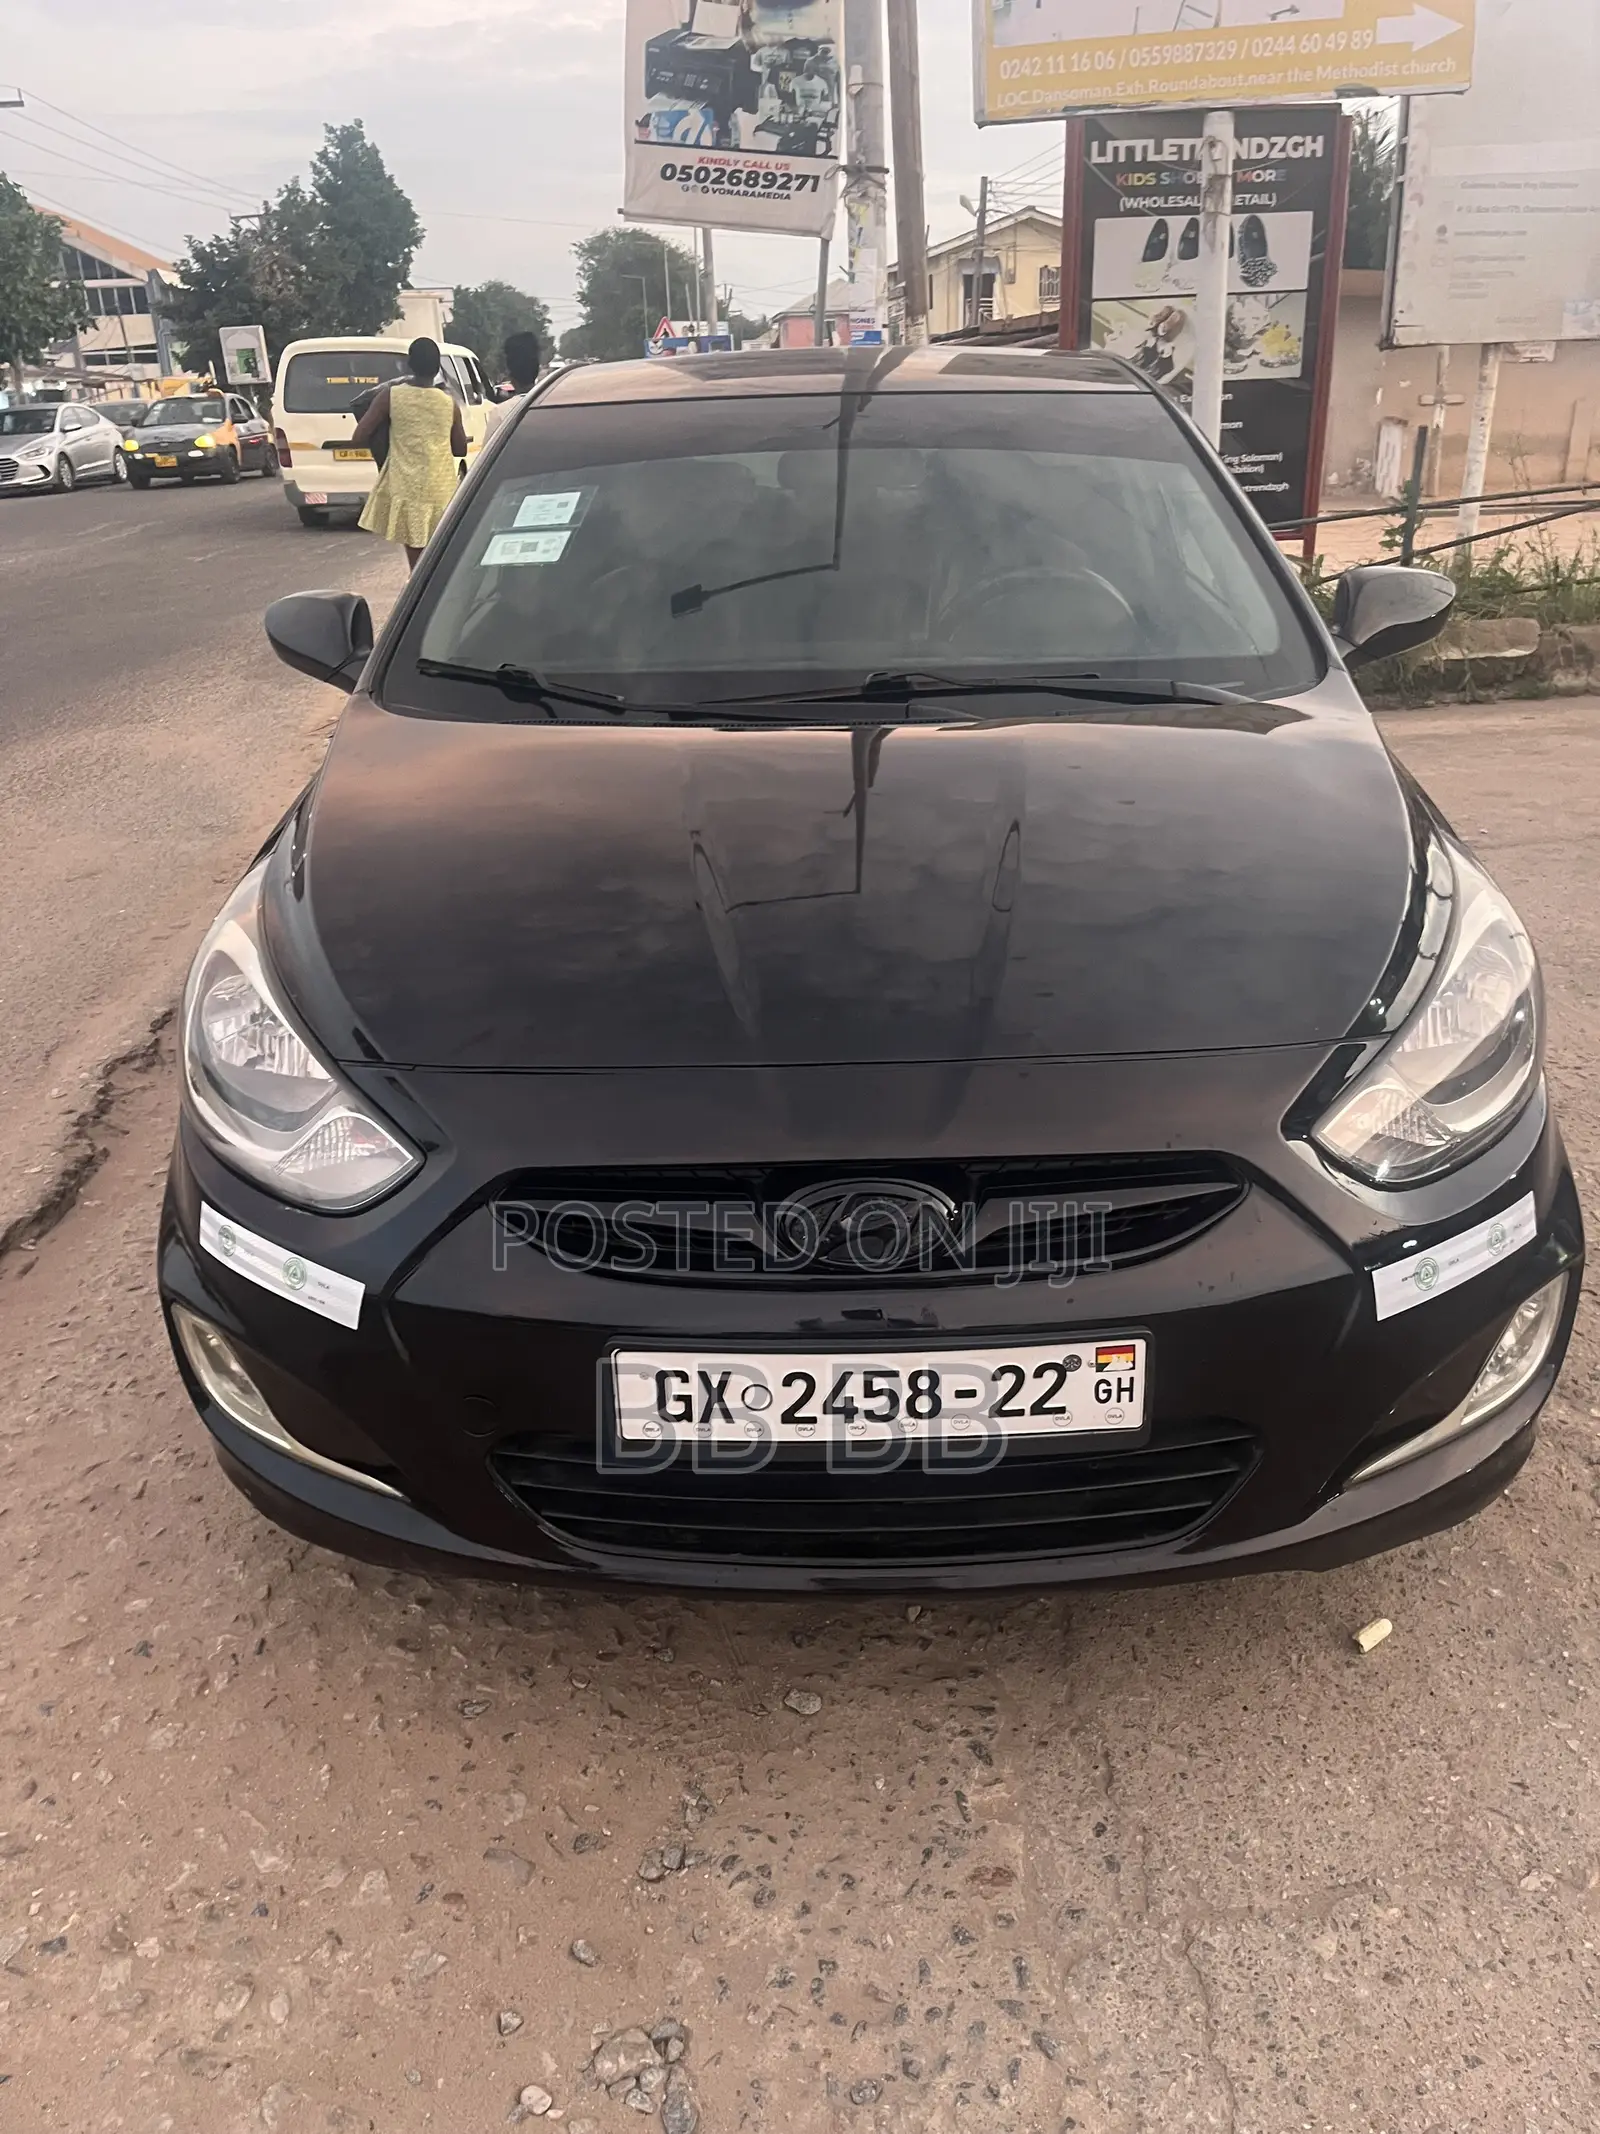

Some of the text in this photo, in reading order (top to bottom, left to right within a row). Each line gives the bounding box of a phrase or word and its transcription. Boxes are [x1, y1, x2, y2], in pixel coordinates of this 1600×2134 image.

[1000, 57, 1042, 80] 0242
[1046, 54, 1065, 75] 11
[1070, 52, 1091, 73] 16
[1094, 49, 1116, 71] 06
[1129, 39, 1237, 68] 0559887329
[1252, 34, 1297, 58] 0244
[1299, 32, 1322, 54] 60
[1324, 31, 1347, 51] 49
[1350, 29, 1374, 50] 89
[1286, 67, 1313, 83] the
[1316, 61, 1398, 81] Methodist
[1402, 57, 1456, 75] church
[1090, 136, 1324, 163] LITTLETNDZGH
[697, 156, 791, 171] KINDLY CALL US
[660, 163, 820, 192] 0502689271
[1116, 172, 1156, 187] KIDS
[1237, 168, 1287, 183] MORE
[1119, 193, 1277, 212] (WHOLESAL ETAIL)
[655, 1369, 735, 1425] GX
[1094, 1376, 1134, 1404] GH
